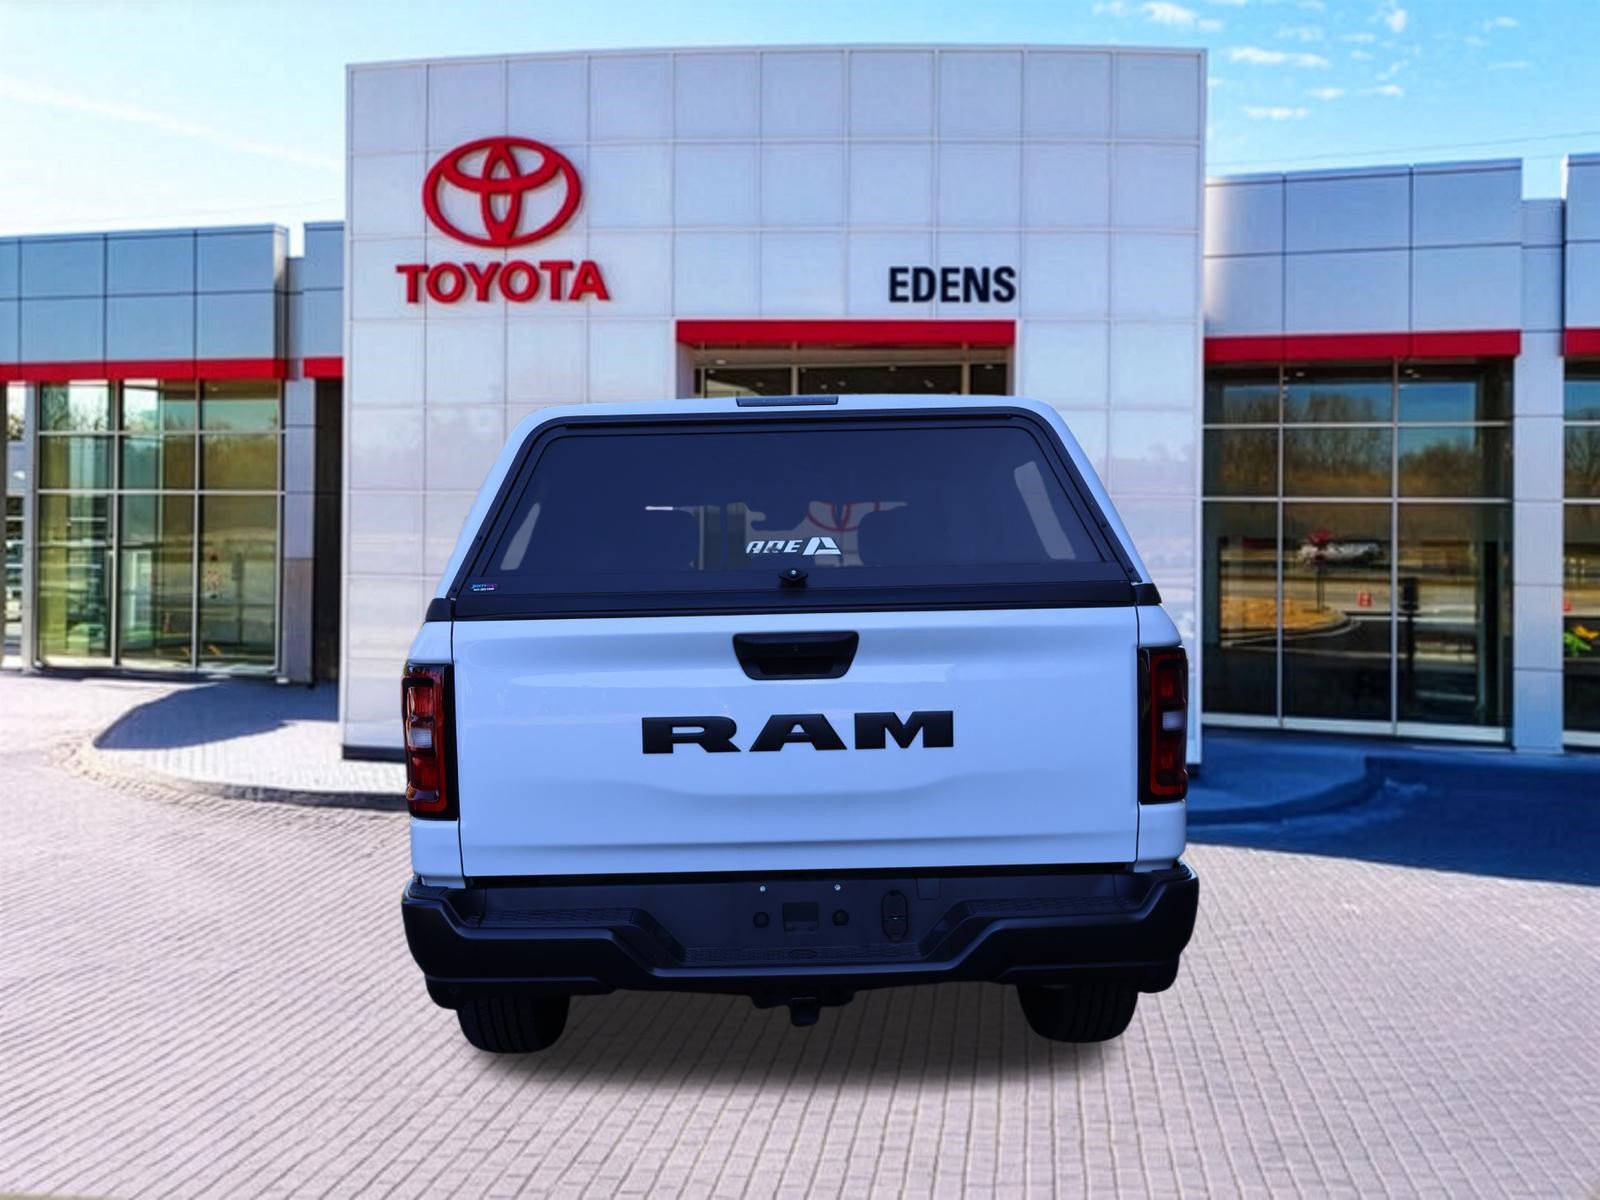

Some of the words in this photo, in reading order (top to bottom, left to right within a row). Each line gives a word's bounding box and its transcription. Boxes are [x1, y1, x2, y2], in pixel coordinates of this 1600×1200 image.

[396, 260, 610, 304] TOYOTA
[889, 266, 1017, 303] EDENS
[642, 711, 954, 754] RAM
